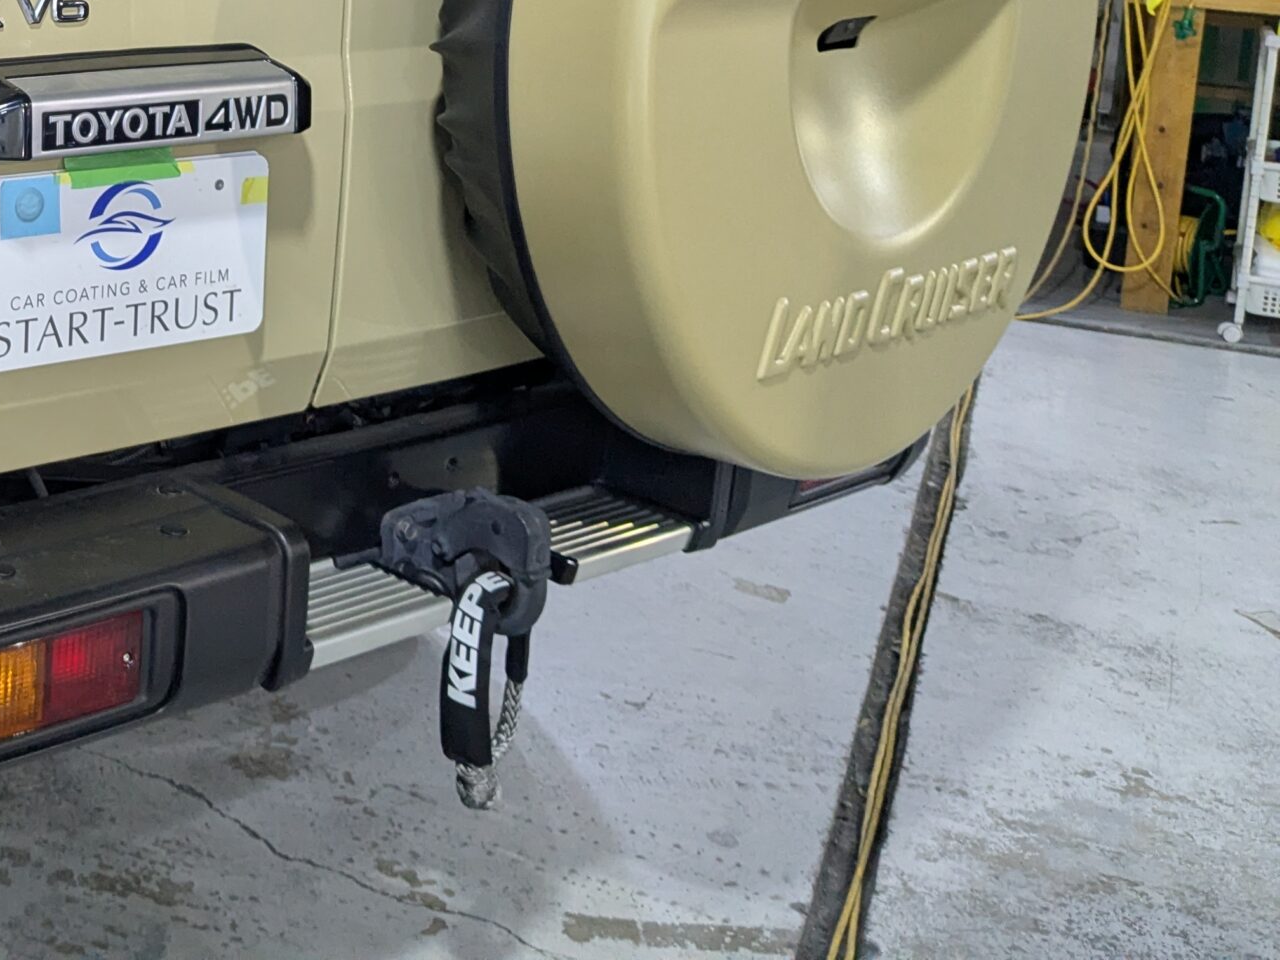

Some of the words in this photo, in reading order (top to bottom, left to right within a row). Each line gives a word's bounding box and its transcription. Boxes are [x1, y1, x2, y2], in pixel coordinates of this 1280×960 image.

[49, 103, 192, 147] TOYOTA
[205, 93, 289, 132] 4WD
[10, 293, 45, 311] CAR
[54, 281, 131, 305] COATING
[138, 279, 148, 293] &
[156, 274, 187, 291] CAR
[195, 268, 229, 285] FILM
[447, 571, 515, 709] KEEPE
